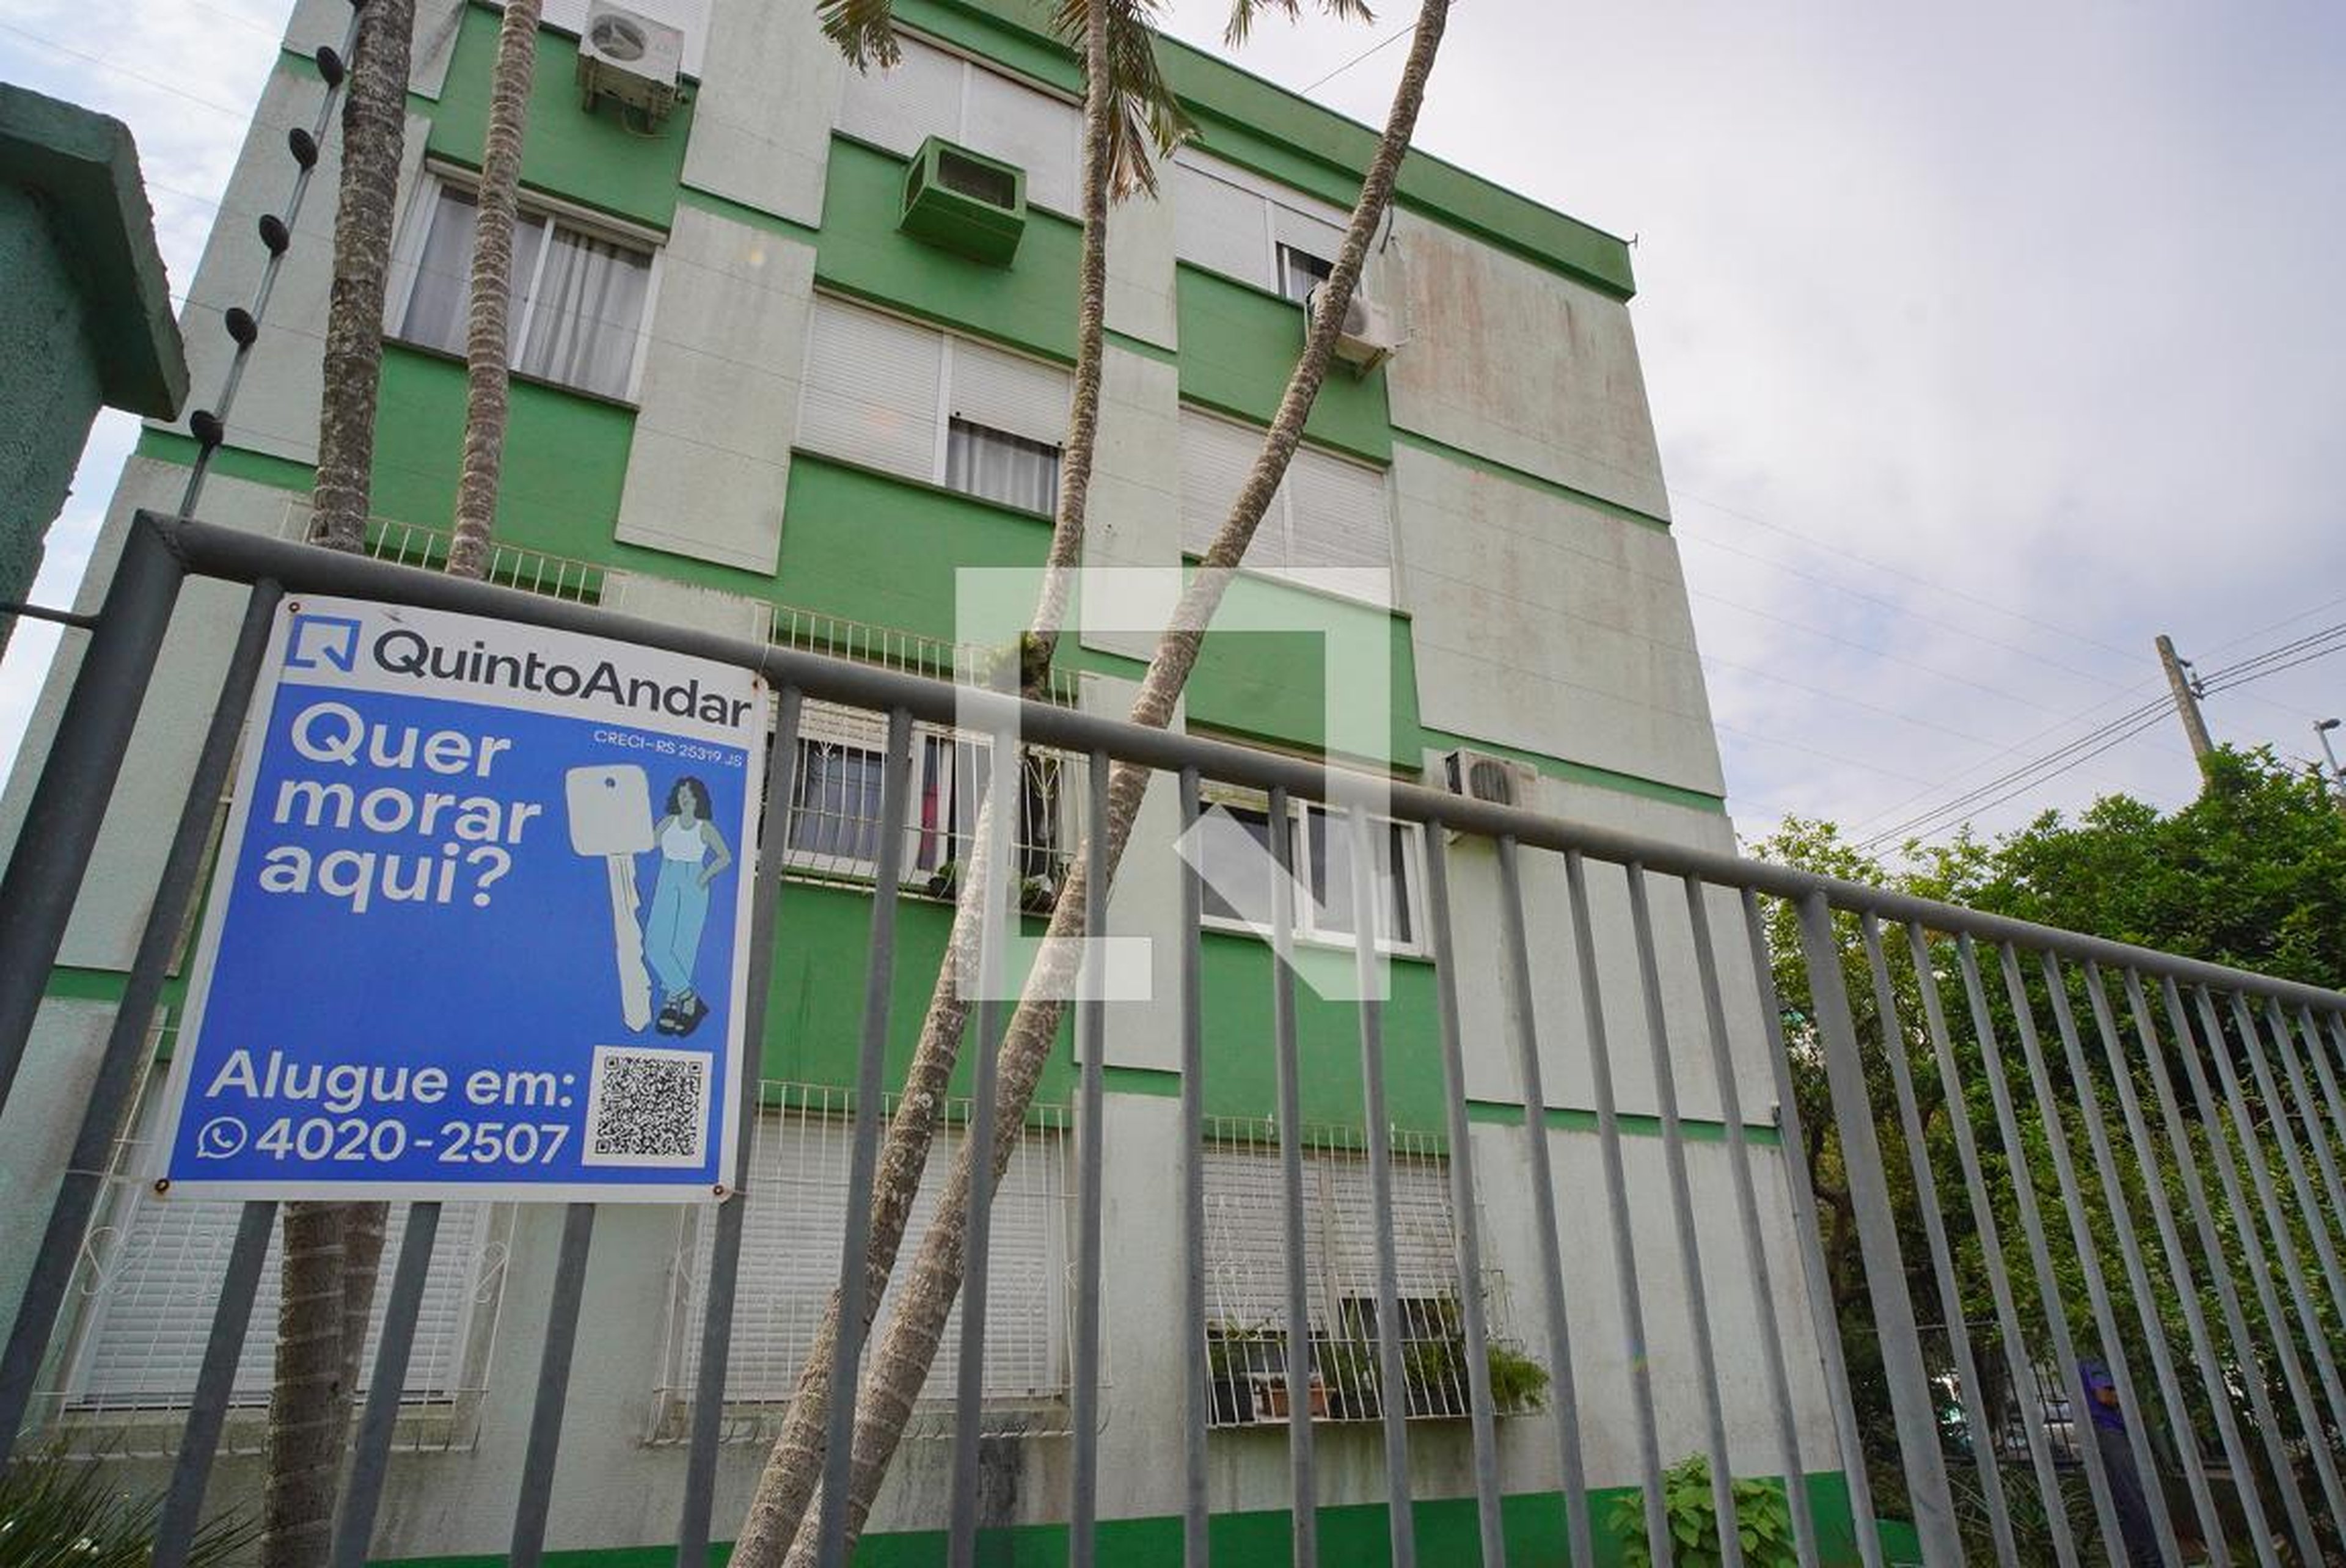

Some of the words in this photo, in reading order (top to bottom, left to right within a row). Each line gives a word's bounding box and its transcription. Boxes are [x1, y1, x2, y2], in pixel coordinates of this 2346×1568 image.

[373, 629, 752, 727] QuintoAndar
[290, 702, 511, 777] Quer
[274, 779, 542, 844] morar
[259, 843, 511, 913] aqui?
[205, 1049, 448, 1114] Alugue
[466, 1070, 575, 1107] em:
